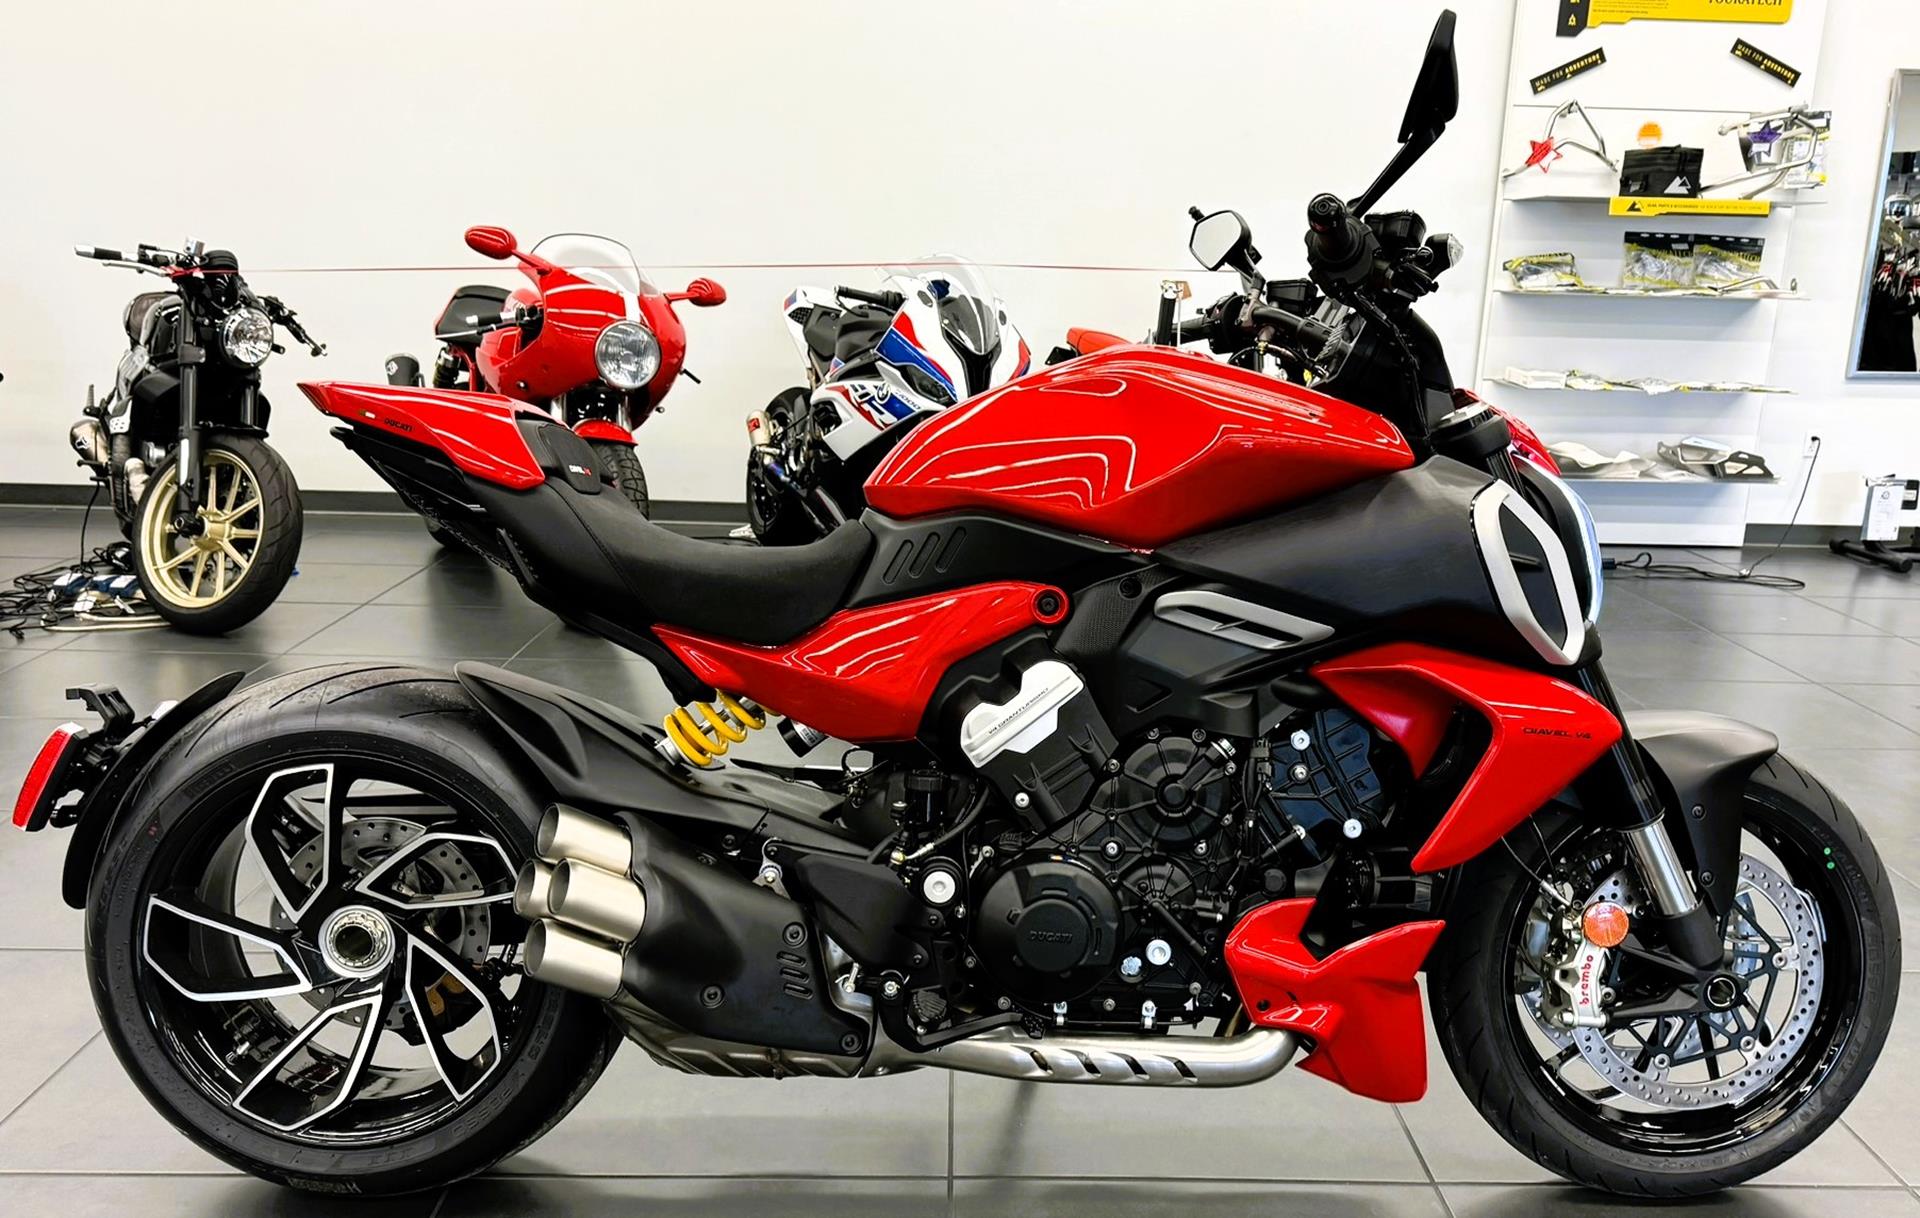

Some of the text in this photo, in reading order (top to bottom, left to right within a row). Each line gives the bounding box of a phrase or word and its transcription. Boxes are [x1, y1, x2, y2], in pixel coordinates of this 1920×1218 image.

[1565, 53, 1600, 75] ADVENTURE
[384, 418, 413, 432] DUCATI
[1523, 727, 1592, 740] DIAVEL V4
[1030, 930, 1073, 944] DUCATI
[1579, 954, 1594, 1006] brembo
